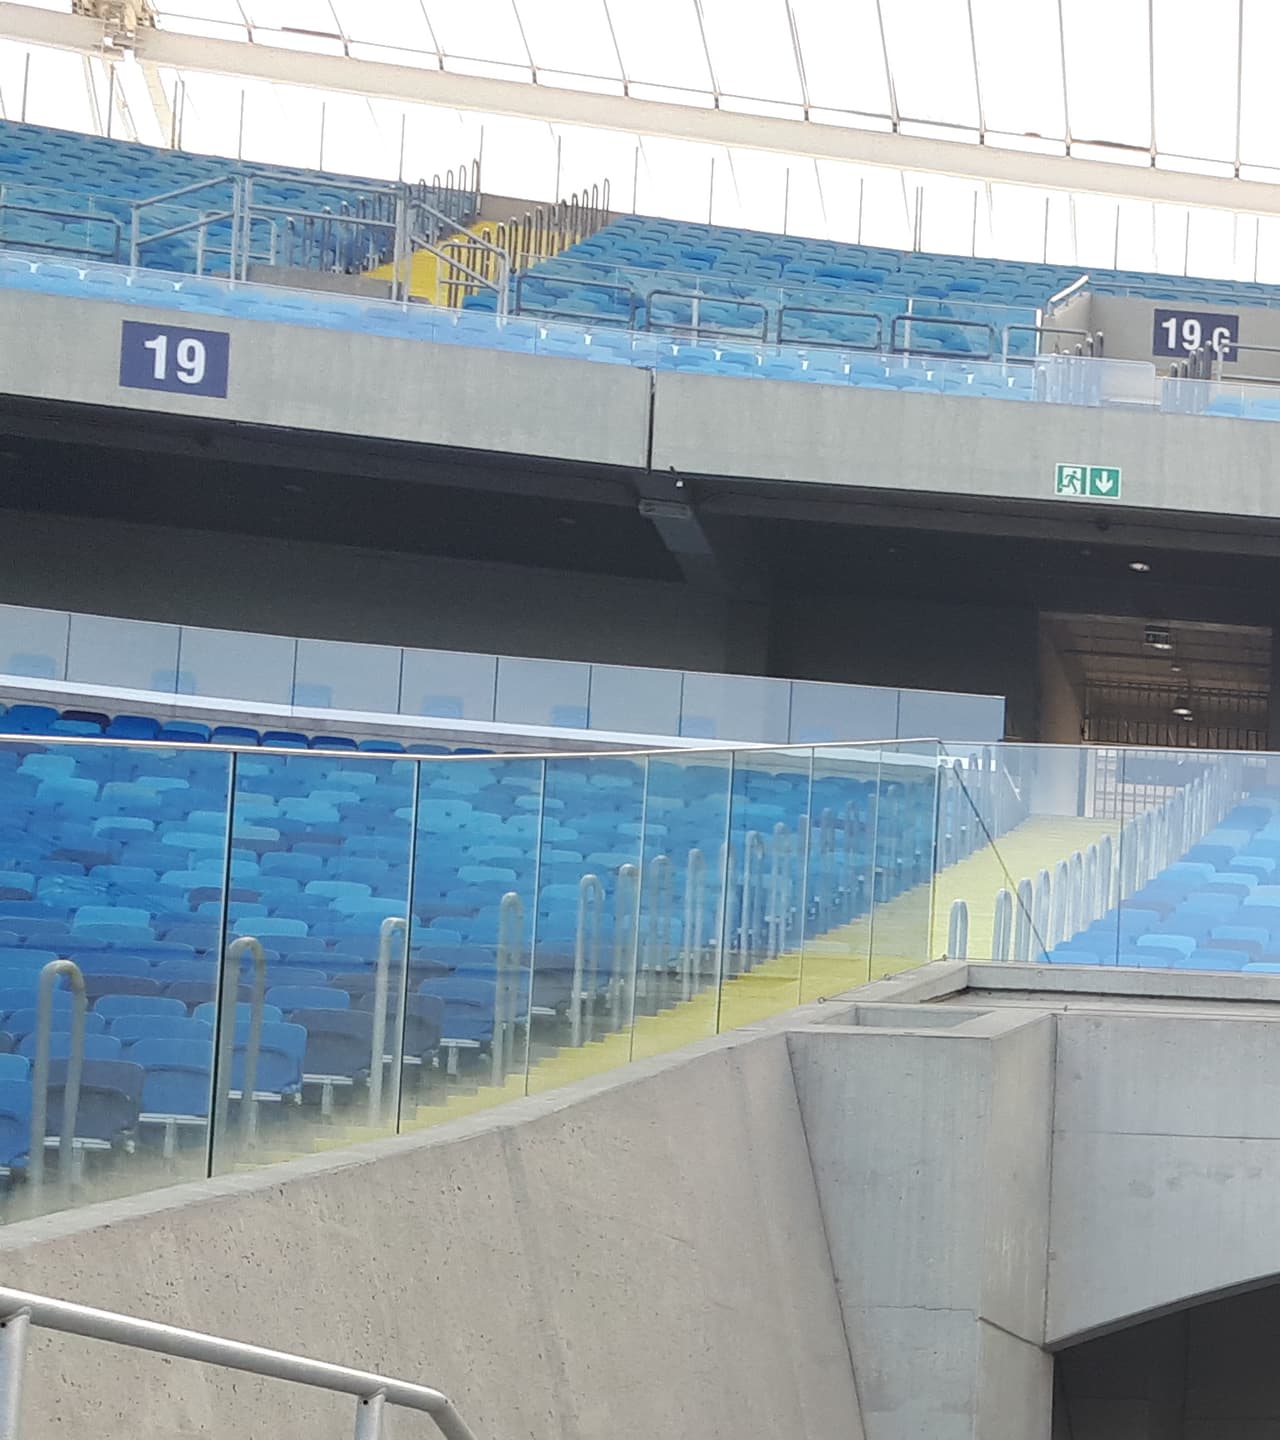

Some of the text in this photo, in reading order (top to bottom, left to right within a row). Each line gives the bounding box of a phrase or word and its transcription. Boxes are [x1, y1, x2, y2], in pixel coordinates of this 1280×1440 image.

[1161, 317, 1231, 353] 19 G
[144, 335, 206, 384] 19
